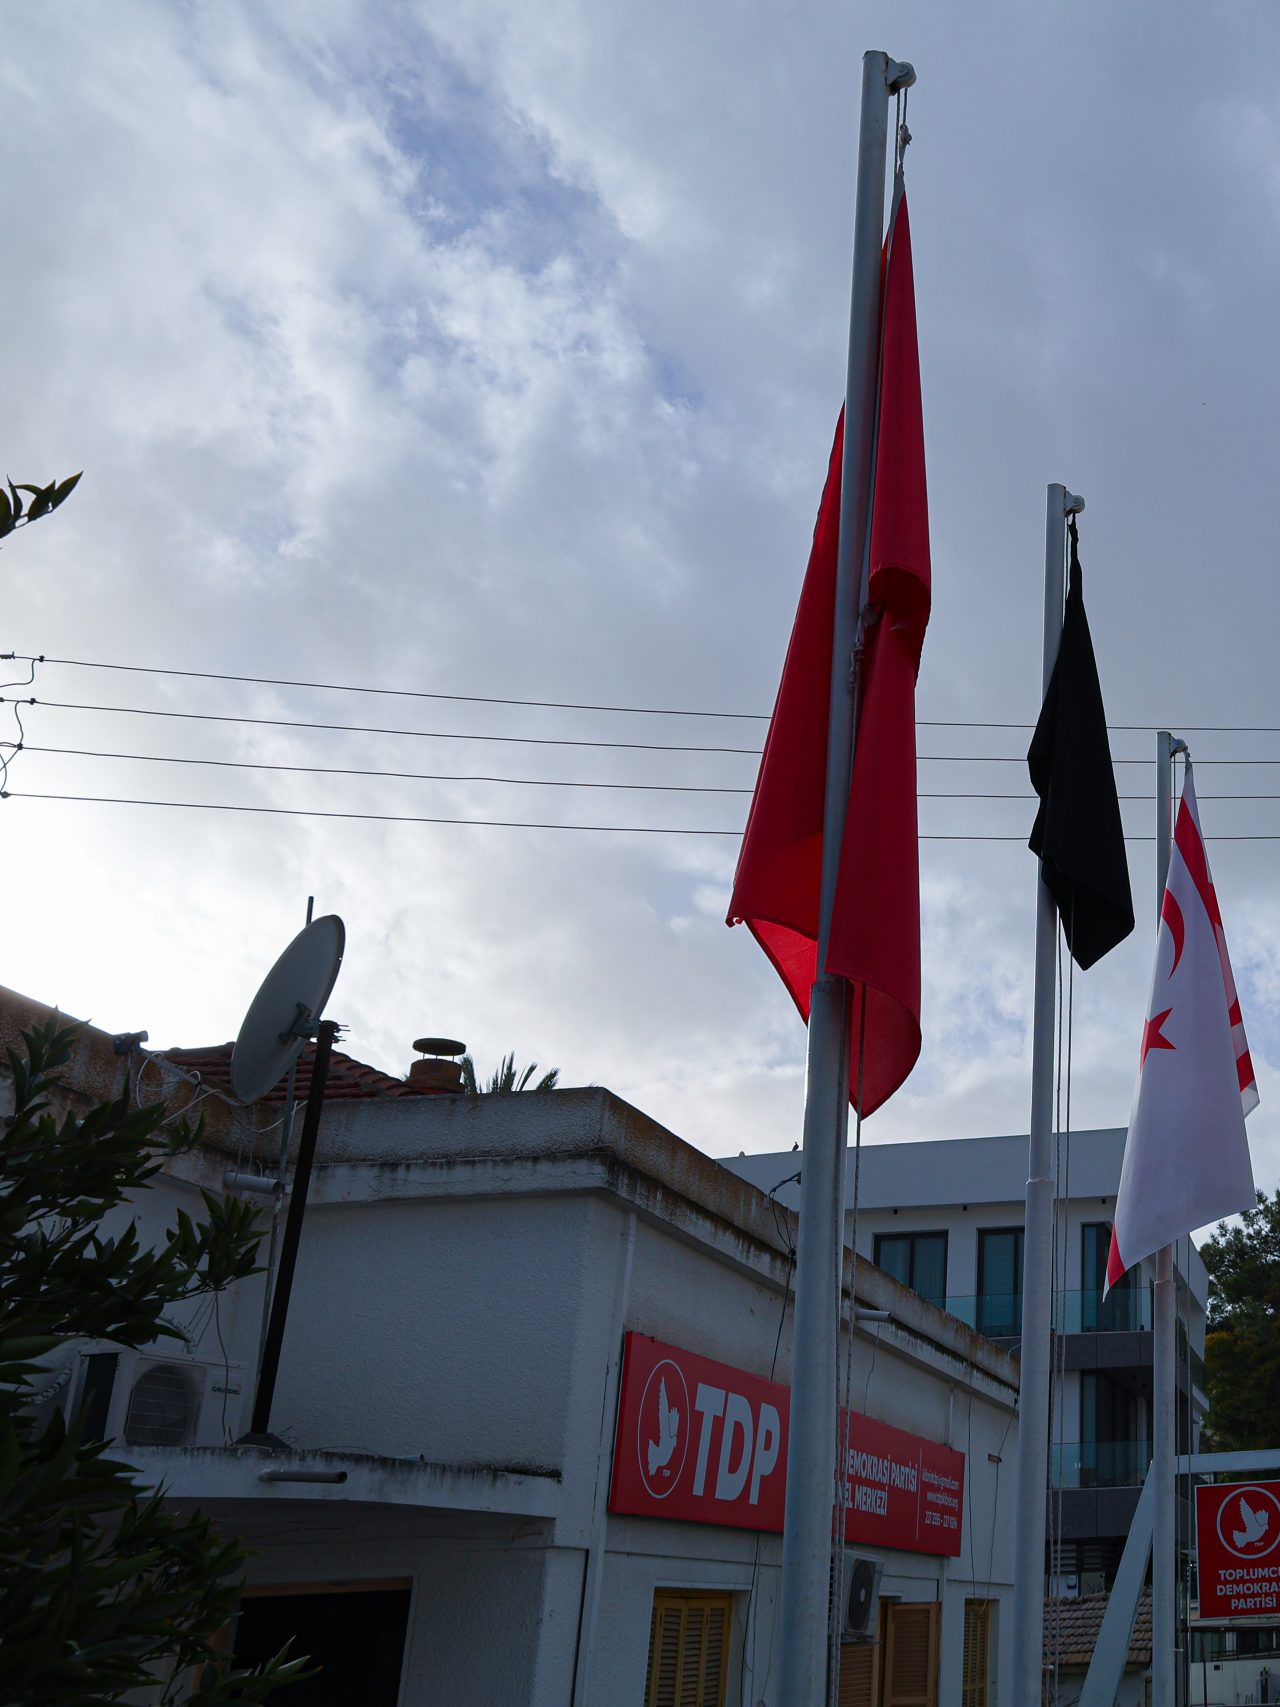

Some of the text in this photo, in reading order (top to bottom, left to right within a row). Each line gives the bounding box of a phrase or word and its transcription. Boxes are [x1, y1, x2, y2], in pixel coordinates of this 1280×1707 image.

[692, 1383, 781, 1505] TDP
[848, 1449, 918, 1493] EMOKRASİ PARTİSİ
[854, 1484, 889, 1516] MERKEZİ
[1231, 1593, 1277, 1610] PARTİSİ
